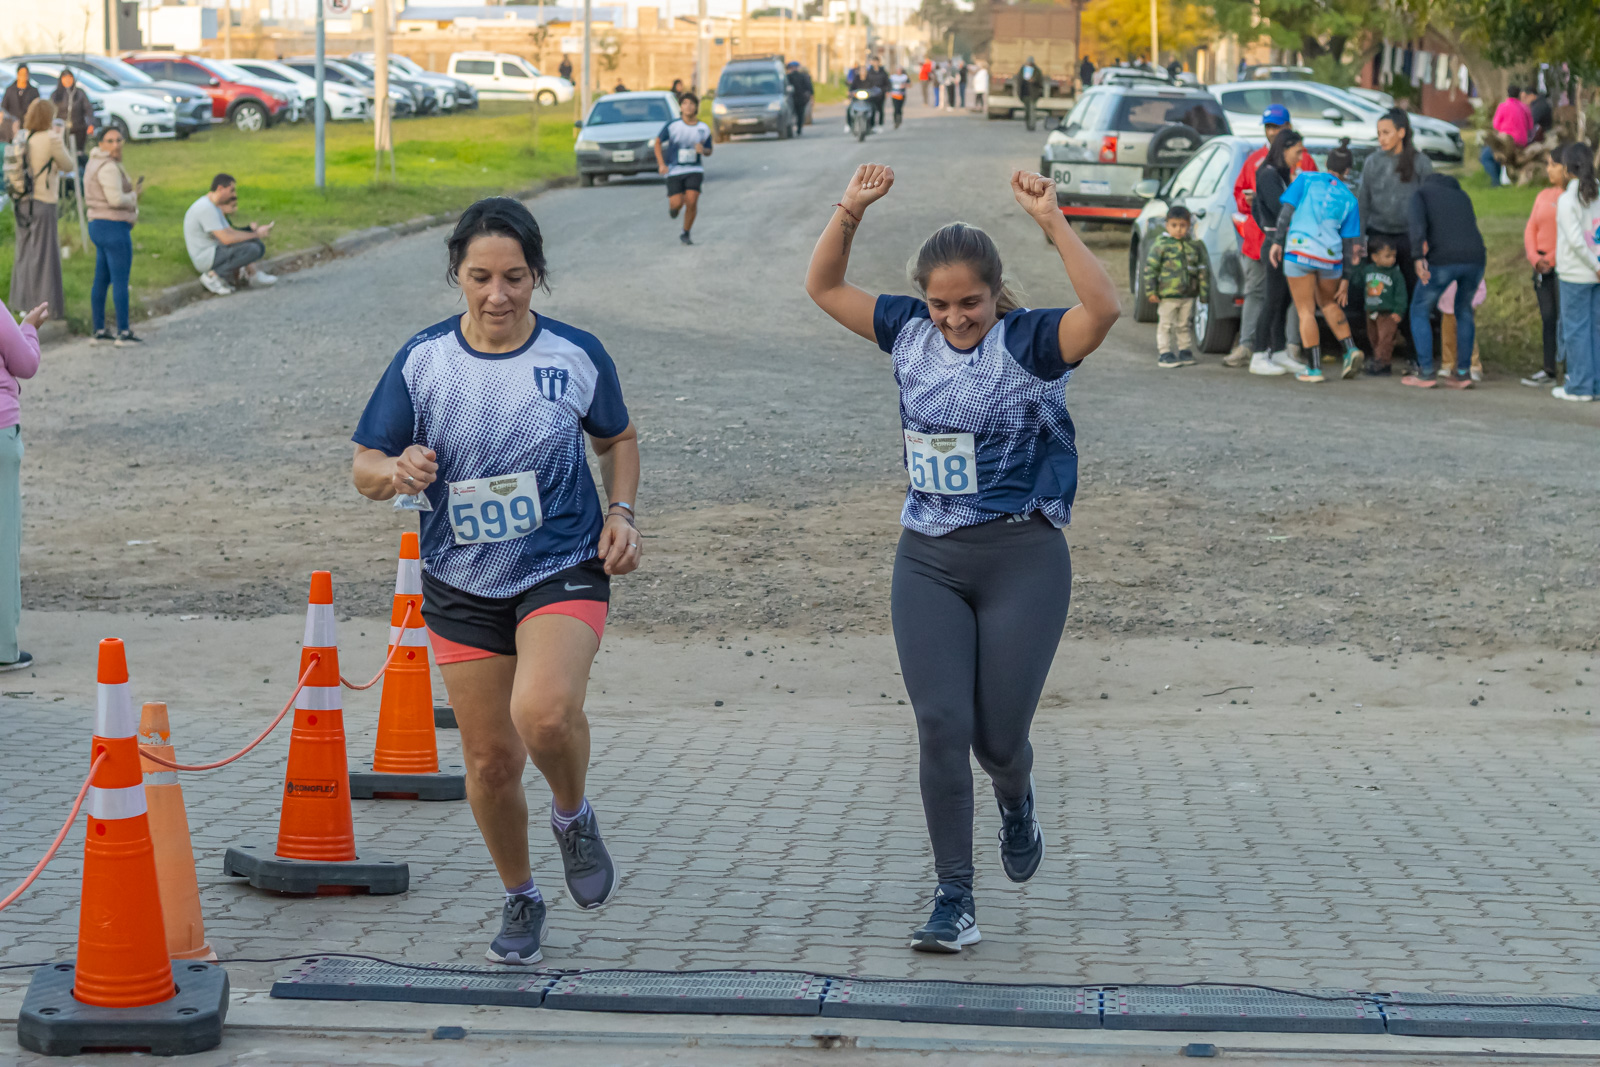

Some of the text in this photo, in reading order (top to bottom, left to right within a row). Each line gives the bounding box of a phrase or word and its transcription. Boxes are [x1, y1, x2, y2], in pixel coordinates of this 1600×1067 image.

[540, 369, 564, 379] SFC
[911, 451, 969, 492] 518
[452, 495, 538, 541] 599
[294, 784, 335, 793] CONOFLEX
